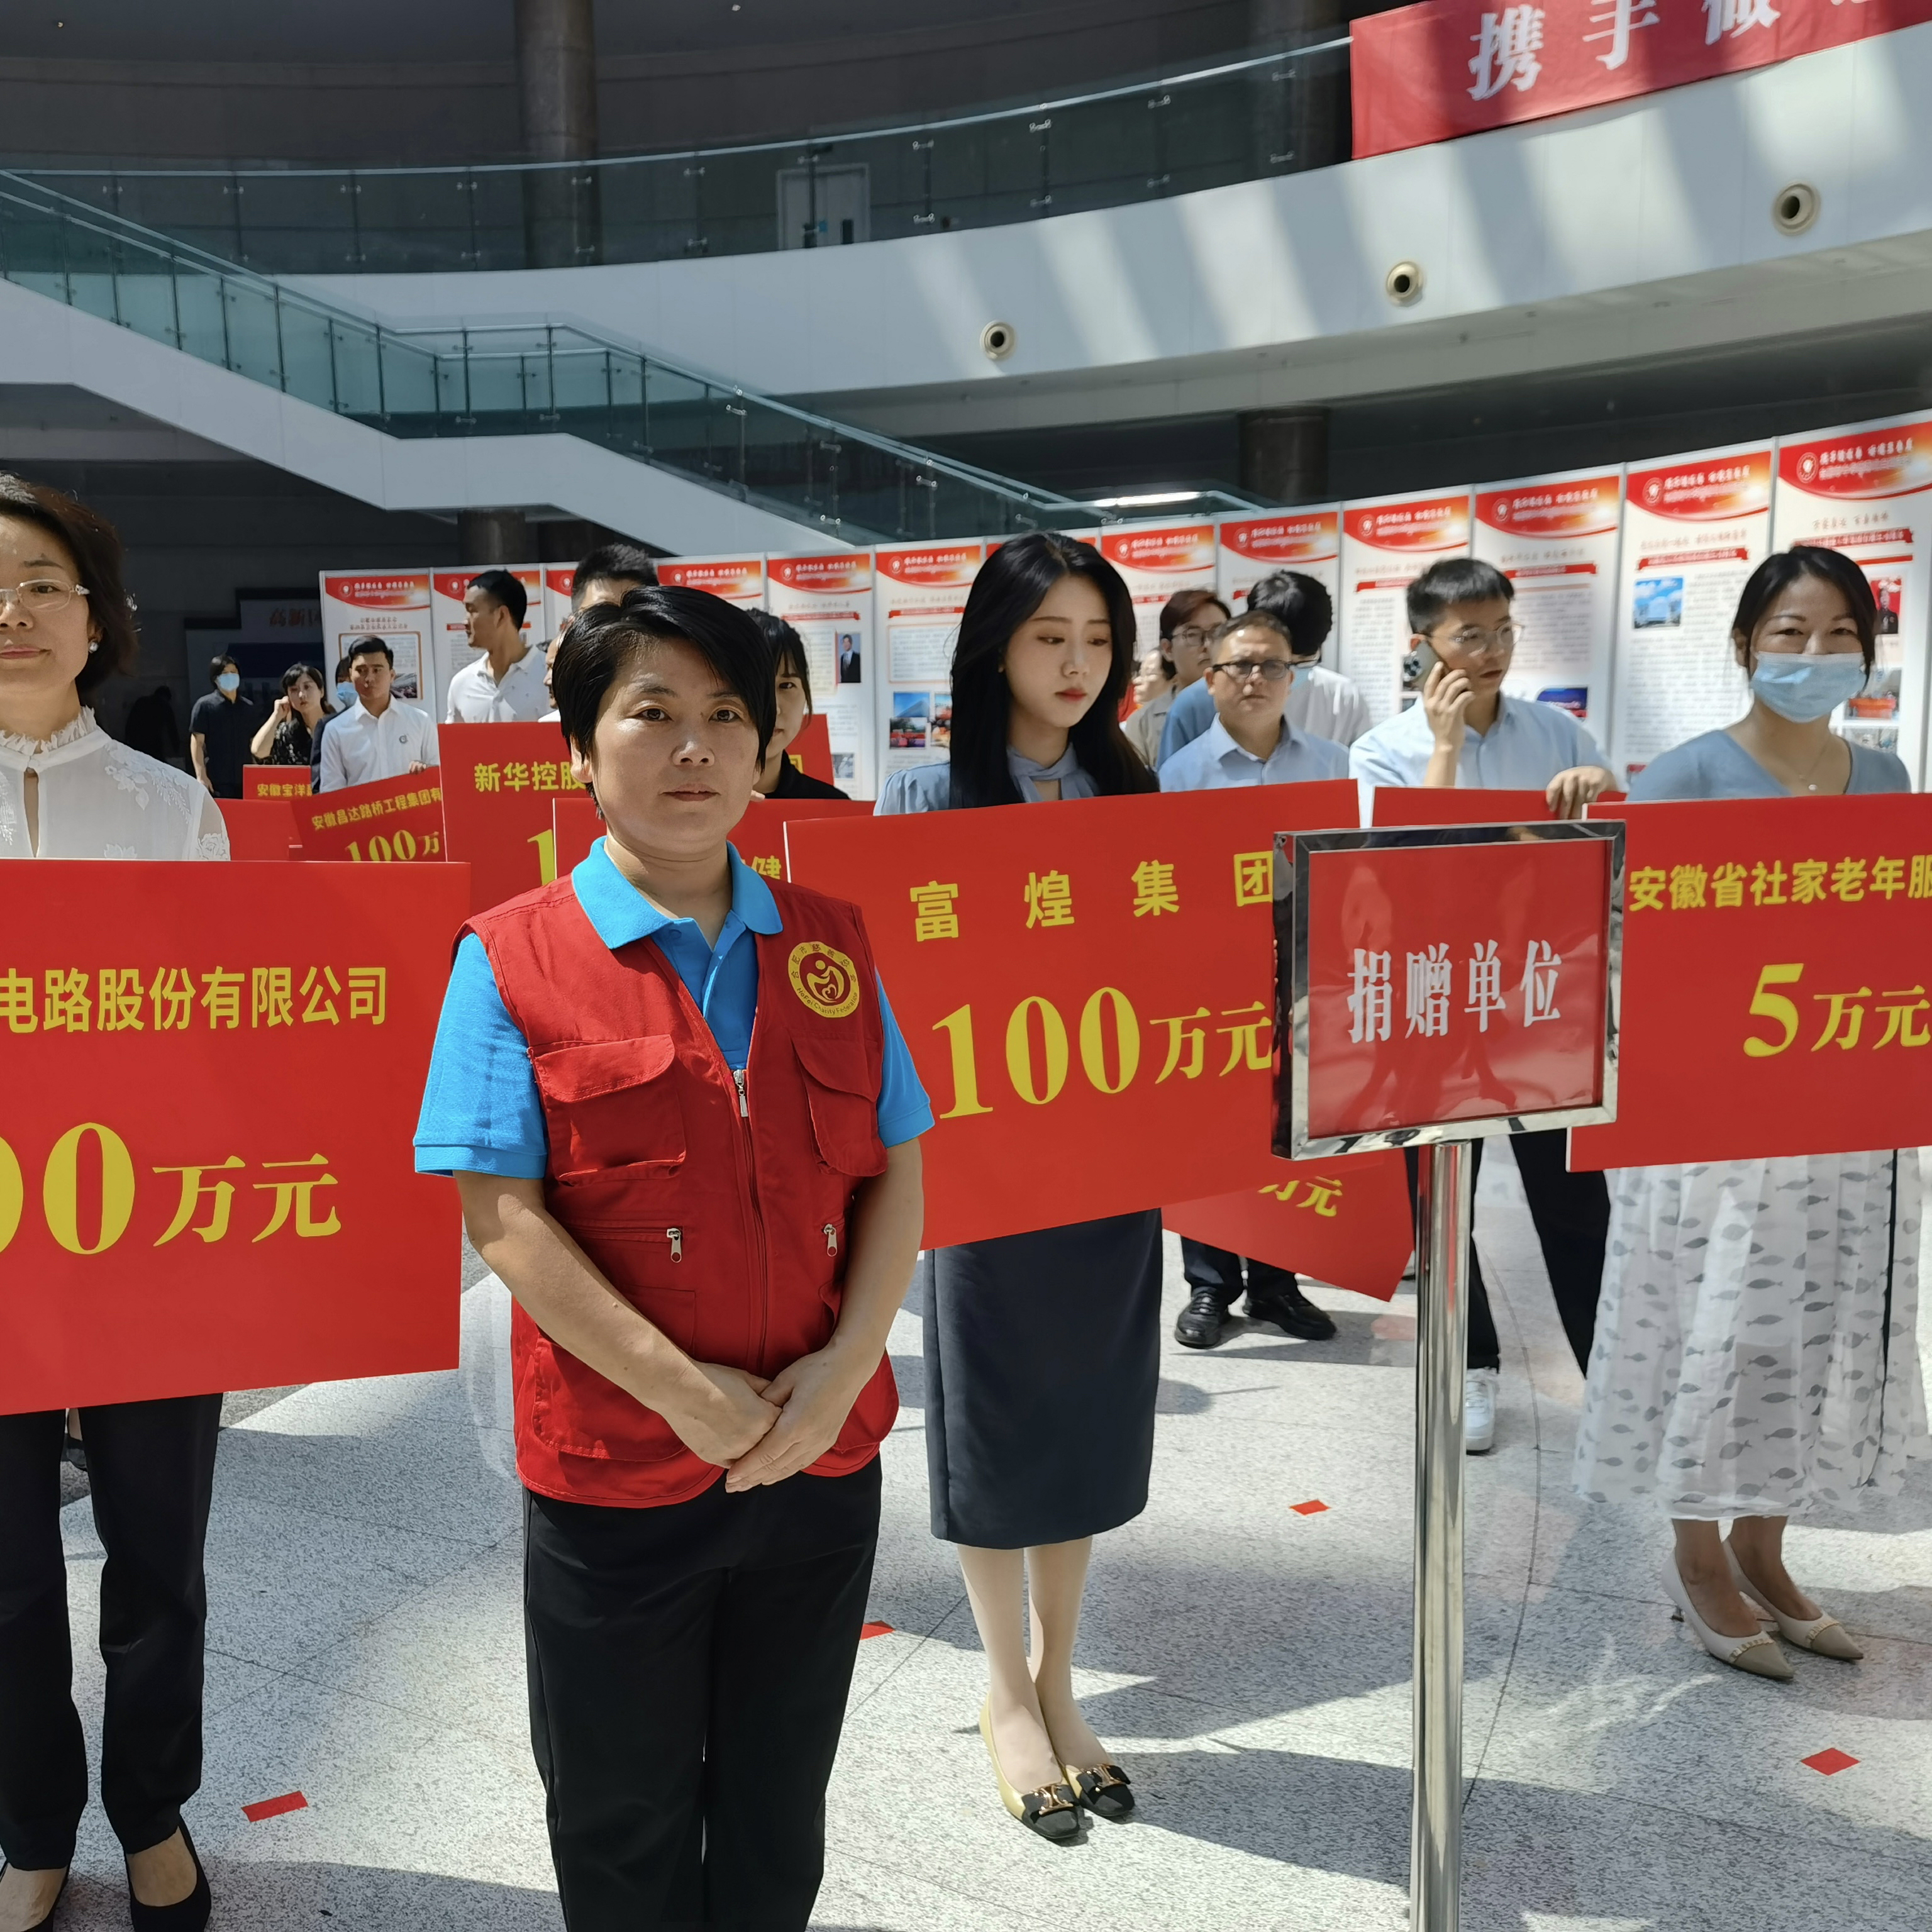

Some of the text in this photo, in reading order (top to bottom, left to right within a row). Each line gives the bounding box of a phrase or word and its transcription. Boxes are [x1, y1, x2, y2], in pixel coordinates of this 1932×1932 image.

[345, 830, 439, 862] 100万
[910, 851, 1273, 942] 富煌集团
[0, 966, 386, 1033] 电路股份有限公司
[1346, 939, 1562, 1043] 捐赠单位
[1743, 963, 1931, 1058] 5万元
[932, 987, 1272, 1119] 100万元
[0, 1121, 341, 1255] 0万元
